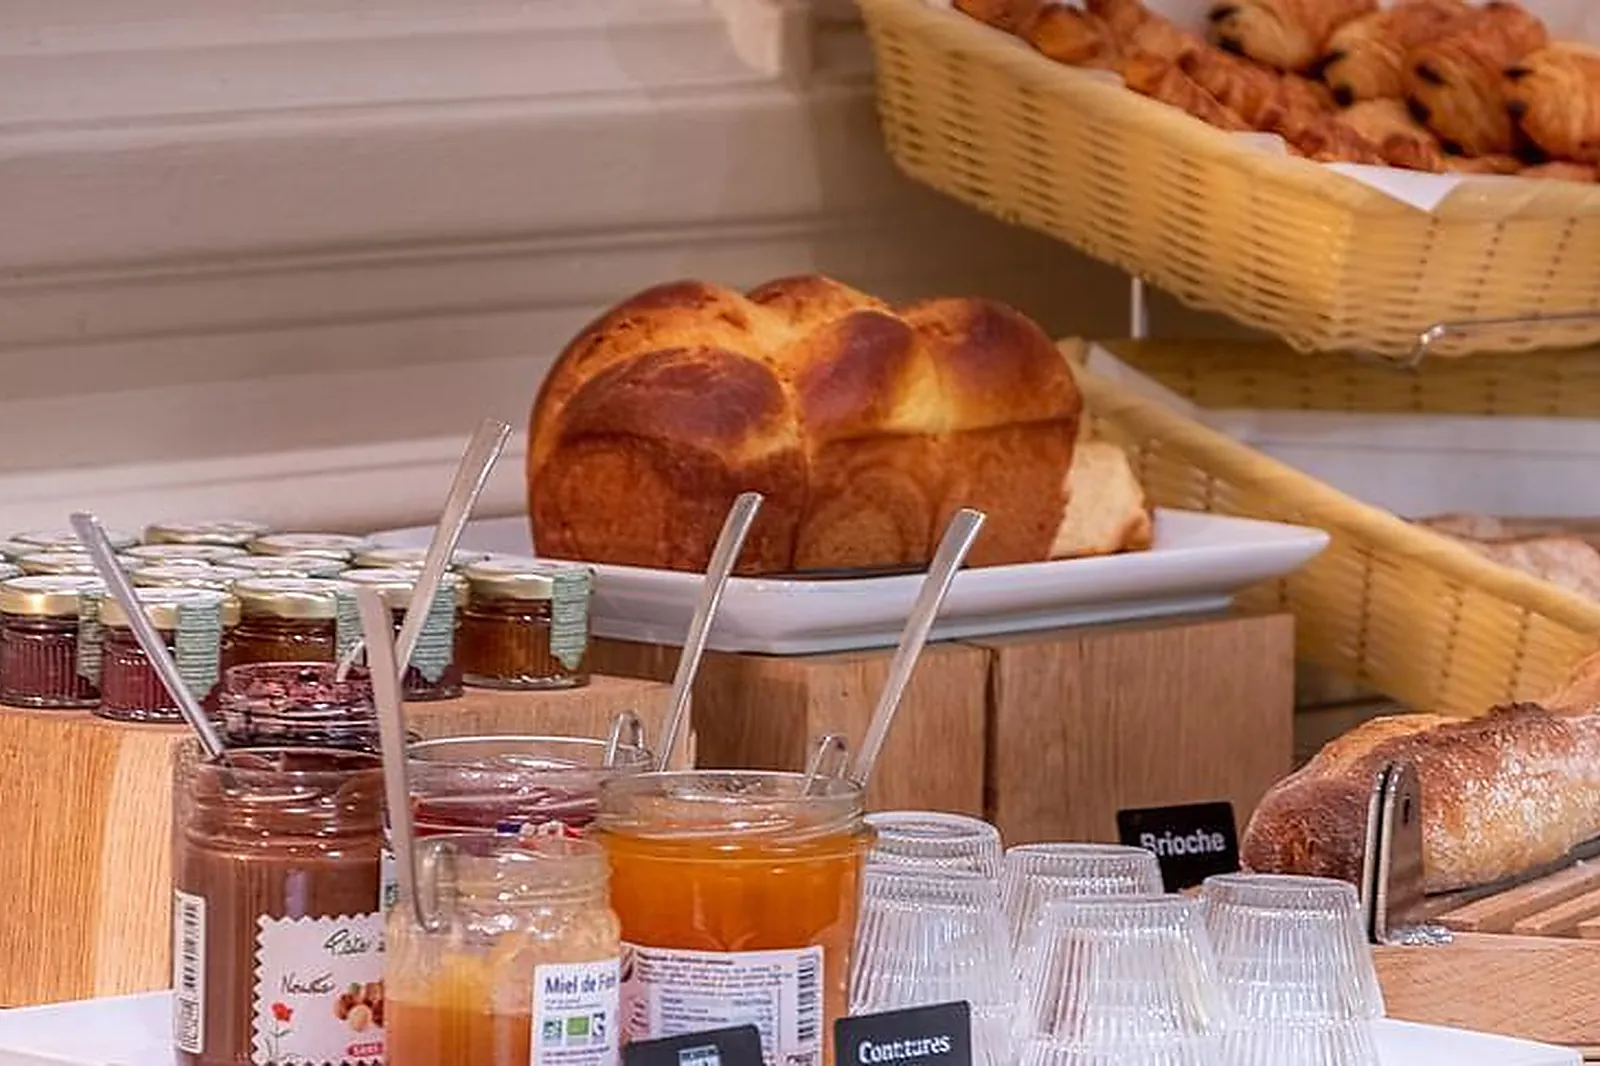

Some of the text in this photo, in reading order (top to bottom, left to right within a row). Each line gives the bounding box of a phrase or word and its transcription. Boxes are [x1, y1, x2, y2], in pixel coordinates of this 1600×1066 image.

[1140, 828, 1226, 856] Brioche
[544, 972, 578, 994] Miel
[581, 973, 596, 993] de
